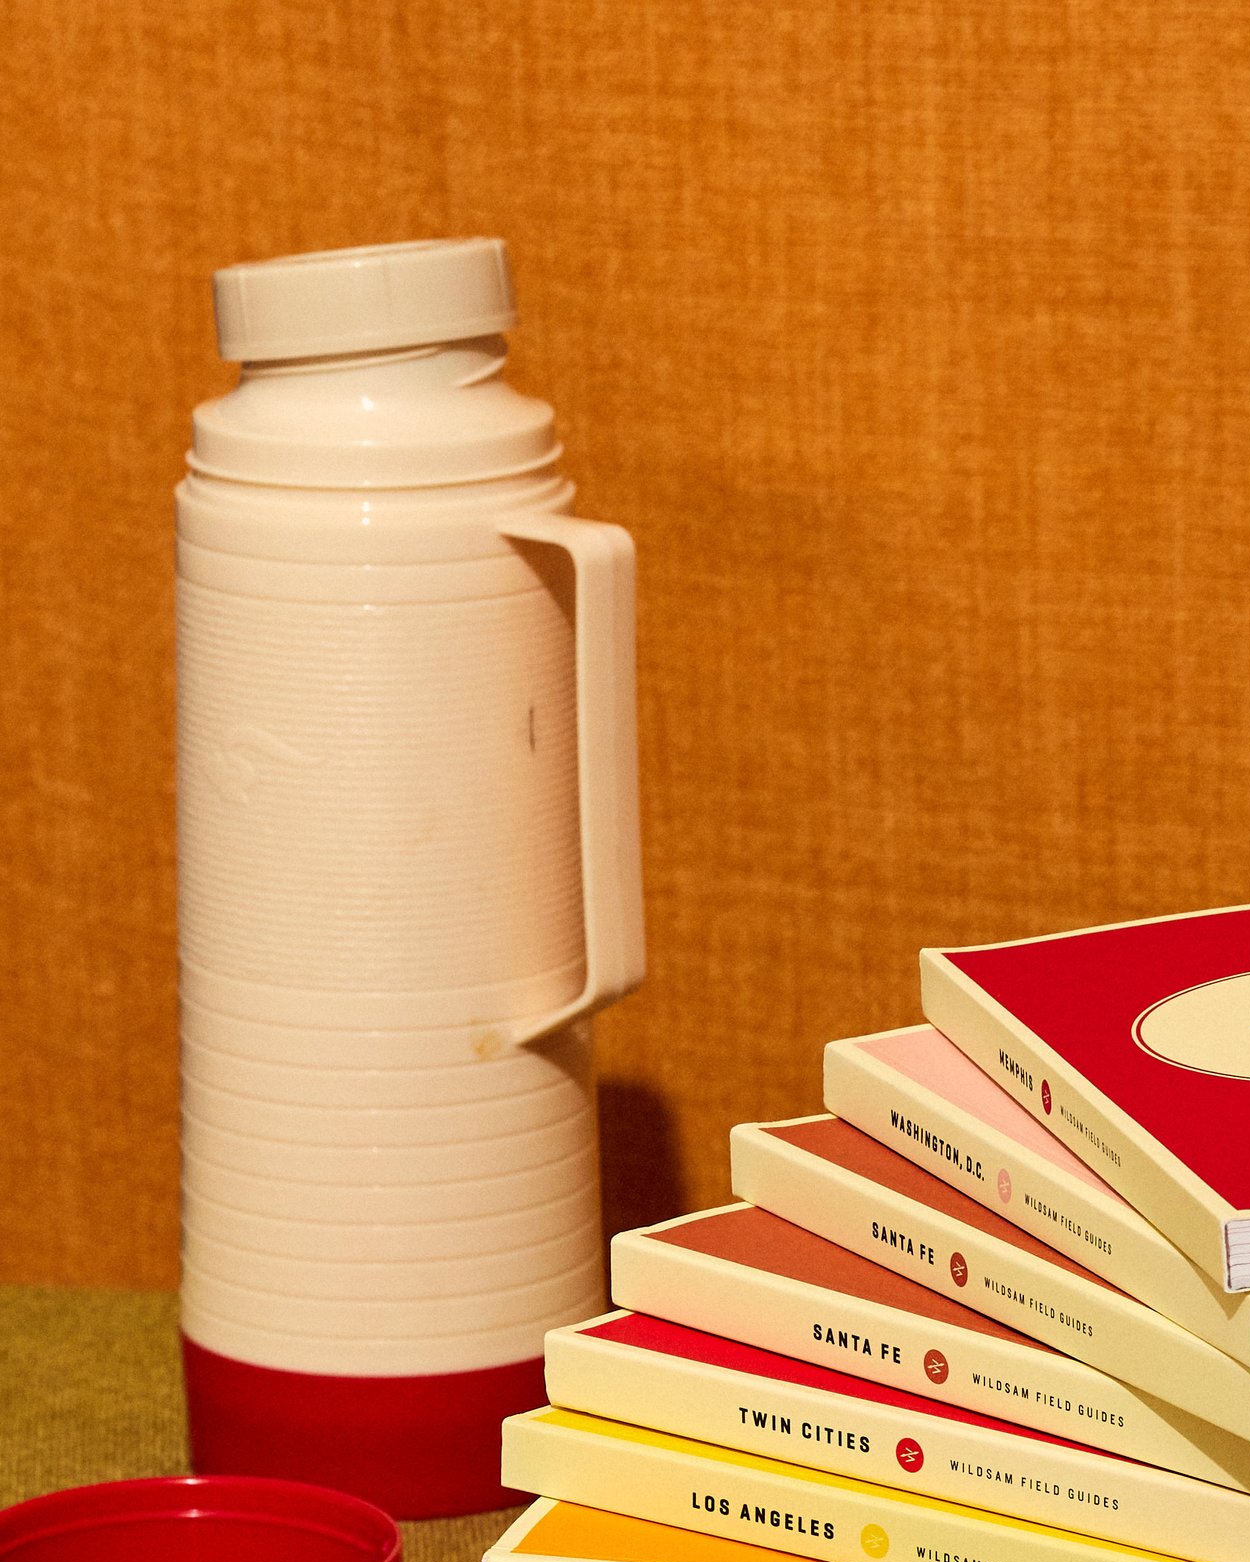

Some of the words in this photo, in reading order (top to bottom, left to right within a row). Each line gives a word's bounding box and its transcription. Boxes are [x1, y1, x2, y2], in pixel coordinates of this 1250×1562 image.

[999, 1048, 1034, 1092] MEMPHIS
[1060, 1105, 1084, 1134] WILDSAM
[1084, 1126, 1100, 1149] FIELD
[1101, 1145, 1121, 1168] GUIDES
[890, 1109, 963, 1171] WASHINGTON,
[966, 1155, 985, 1182] D.C.
[1024, 1193, 1058, 1223] WILDSAM
[1060, 1215, 1082, 1237] FIELD
[1084, 1230, 1112, 1256] GUIDES
[872, 1221, 914, 1256] SANTA
[919, 1243, 935, 1266] FE
[984, 1276, 1025, 1305] WILDSAM
[1029, 1297, 1055, 1319] FIELD
[1059, 1312, 1093, 1337] GUIDES
[813, 1323, 872, 1356] SANTA
[880, 1343, 901, 1365] FE
[972, 1372, 1029, 1400] WILDSAM
[1036, 1391, 1071, 1412] FIELD
[1078, 1404, 1124, 1428] GUIDES
[738, 1406, 791, 1435] TWIN
[801, 1422, 870, 1453] CITIES
[949, 1459, 1013, 1485] WILDSAM
[1021, 1476, 1060, 1496] FIELD
[1067, 1488, 1119, 1511] GUIDES
[692, 1491, 730, 1516] LOS
[739, 1503, 835, 1540] ANGELES
